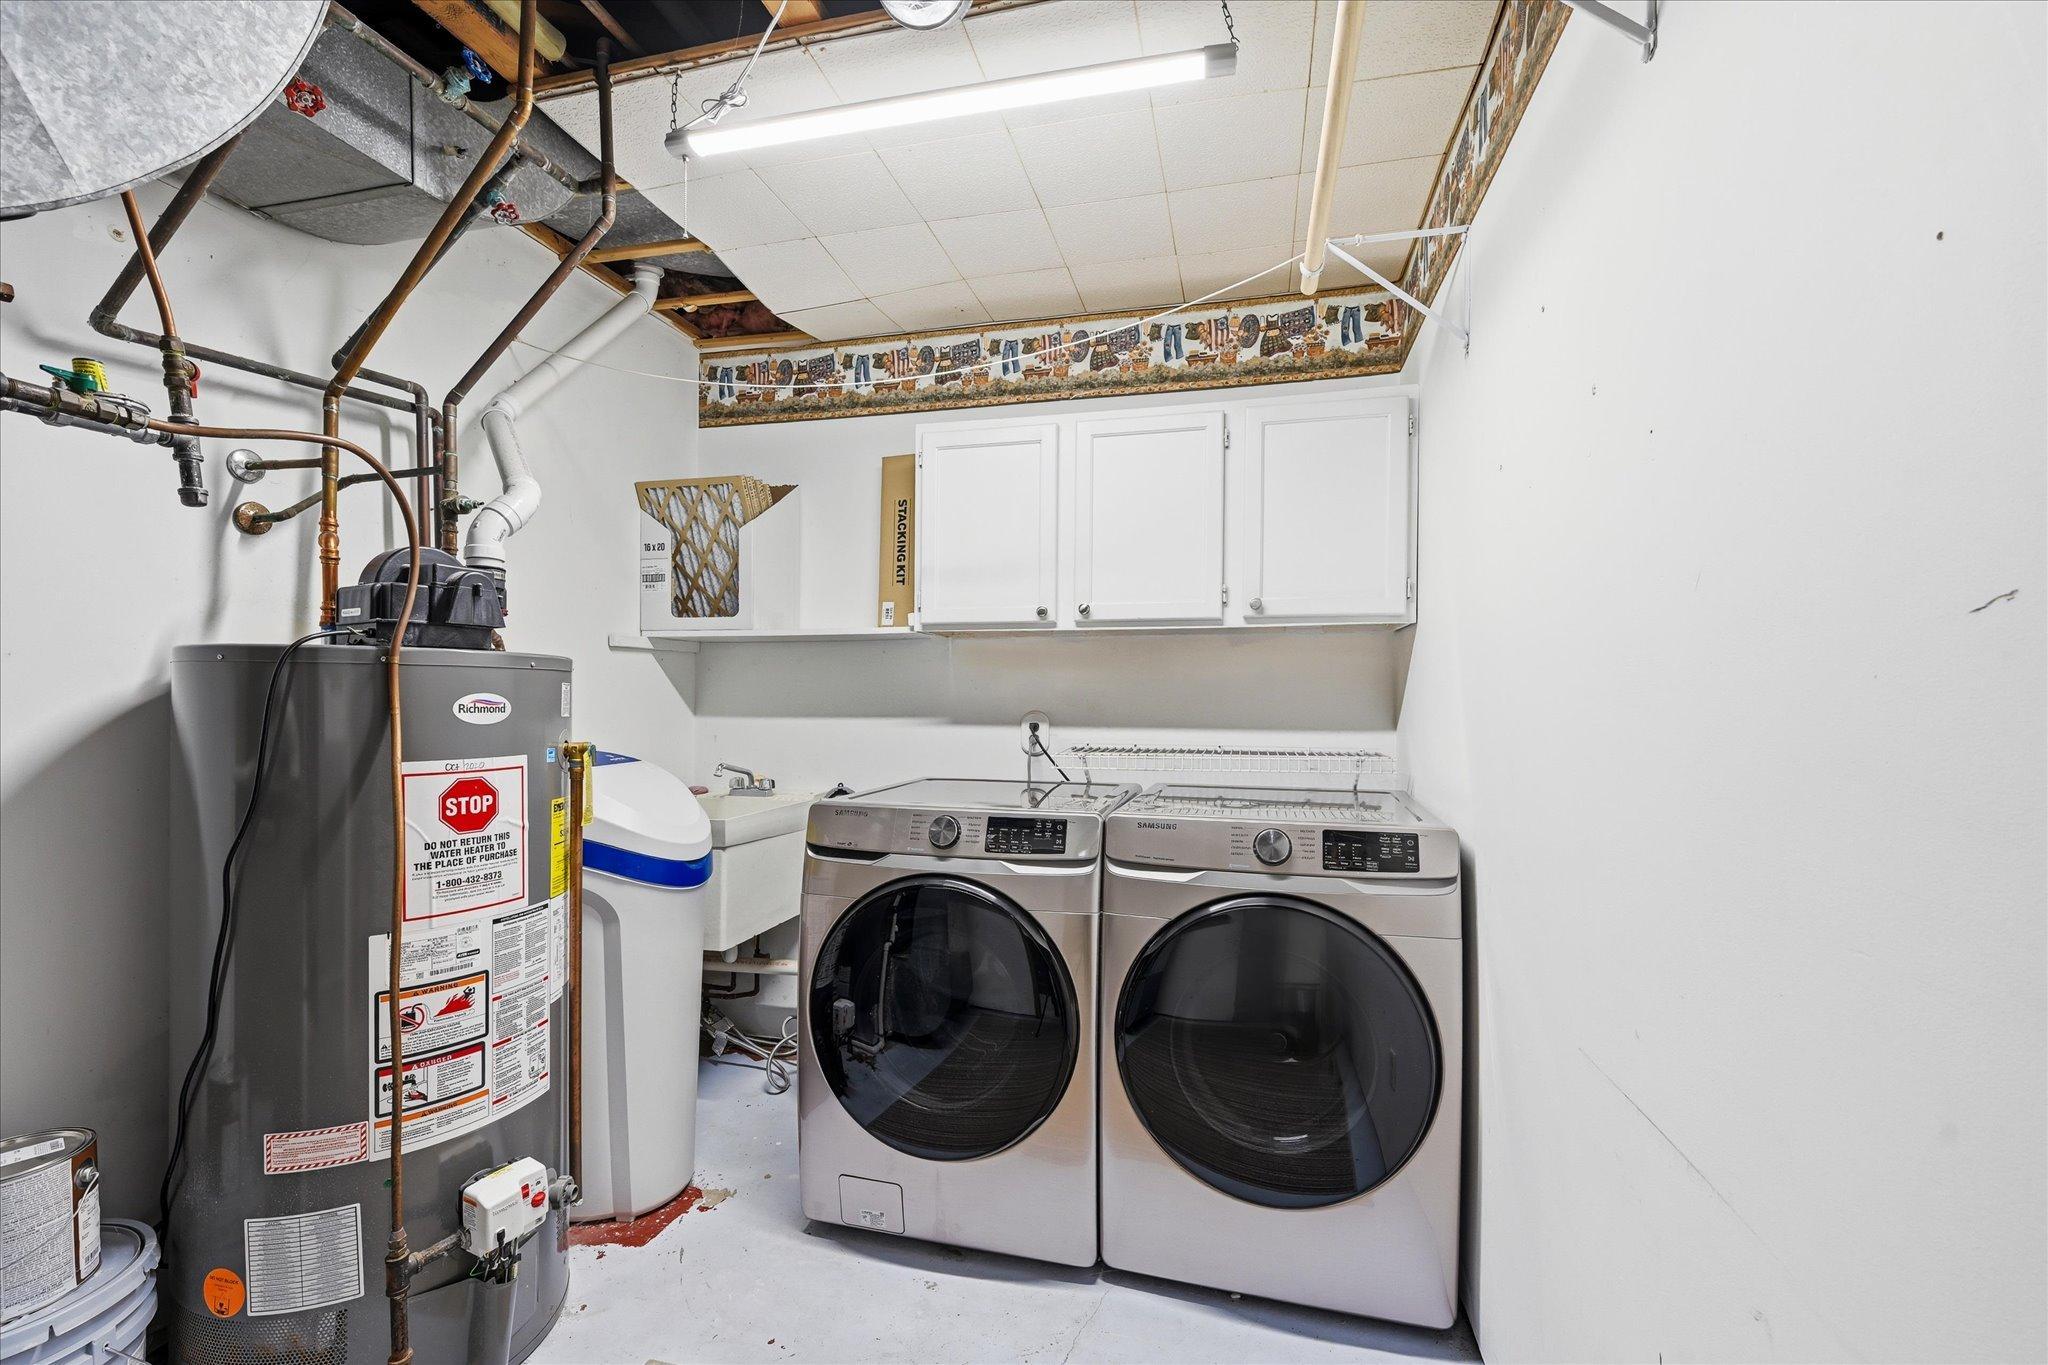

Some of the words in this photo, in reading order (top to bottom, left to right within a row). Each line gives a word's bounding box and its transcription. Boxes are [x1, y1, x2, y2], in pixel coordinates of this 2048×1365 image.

[897, 499, 908, 563] STACKING
[644, 543, 651, 552] 16
[657, 543, 665, 551] 20
[896, 565, 906, 585] KIT
[458, 702, 506, 714] Richmond
[445, 795, 493, 817] STOP
[834, 809, 869, 817] SAMSUNG
[1137, 822, 1177, 831] SAMSUNG
[424, 842, 437, 851] DO
[440, 840, 459, 849] NOT
[460, 835, 492, 847] RETURN
[494, 832, 511, 841] THIS
[430, 849, 461, 860] WATER
[464, 844, 495, 855] HEATER
[497, 842, 506, 851] TO
[414, 862, 432, 872] THE
[435, 858, 464, 869] PLACE
[466, 856, 476, 864] OF
[479, 849, 518, 862] PURCHASE
[436, 870, 503, 889] 1-800-432-8373
[421, 982, 460, 994] WARNING
[420, 1055, 452, 1068] DANGER
